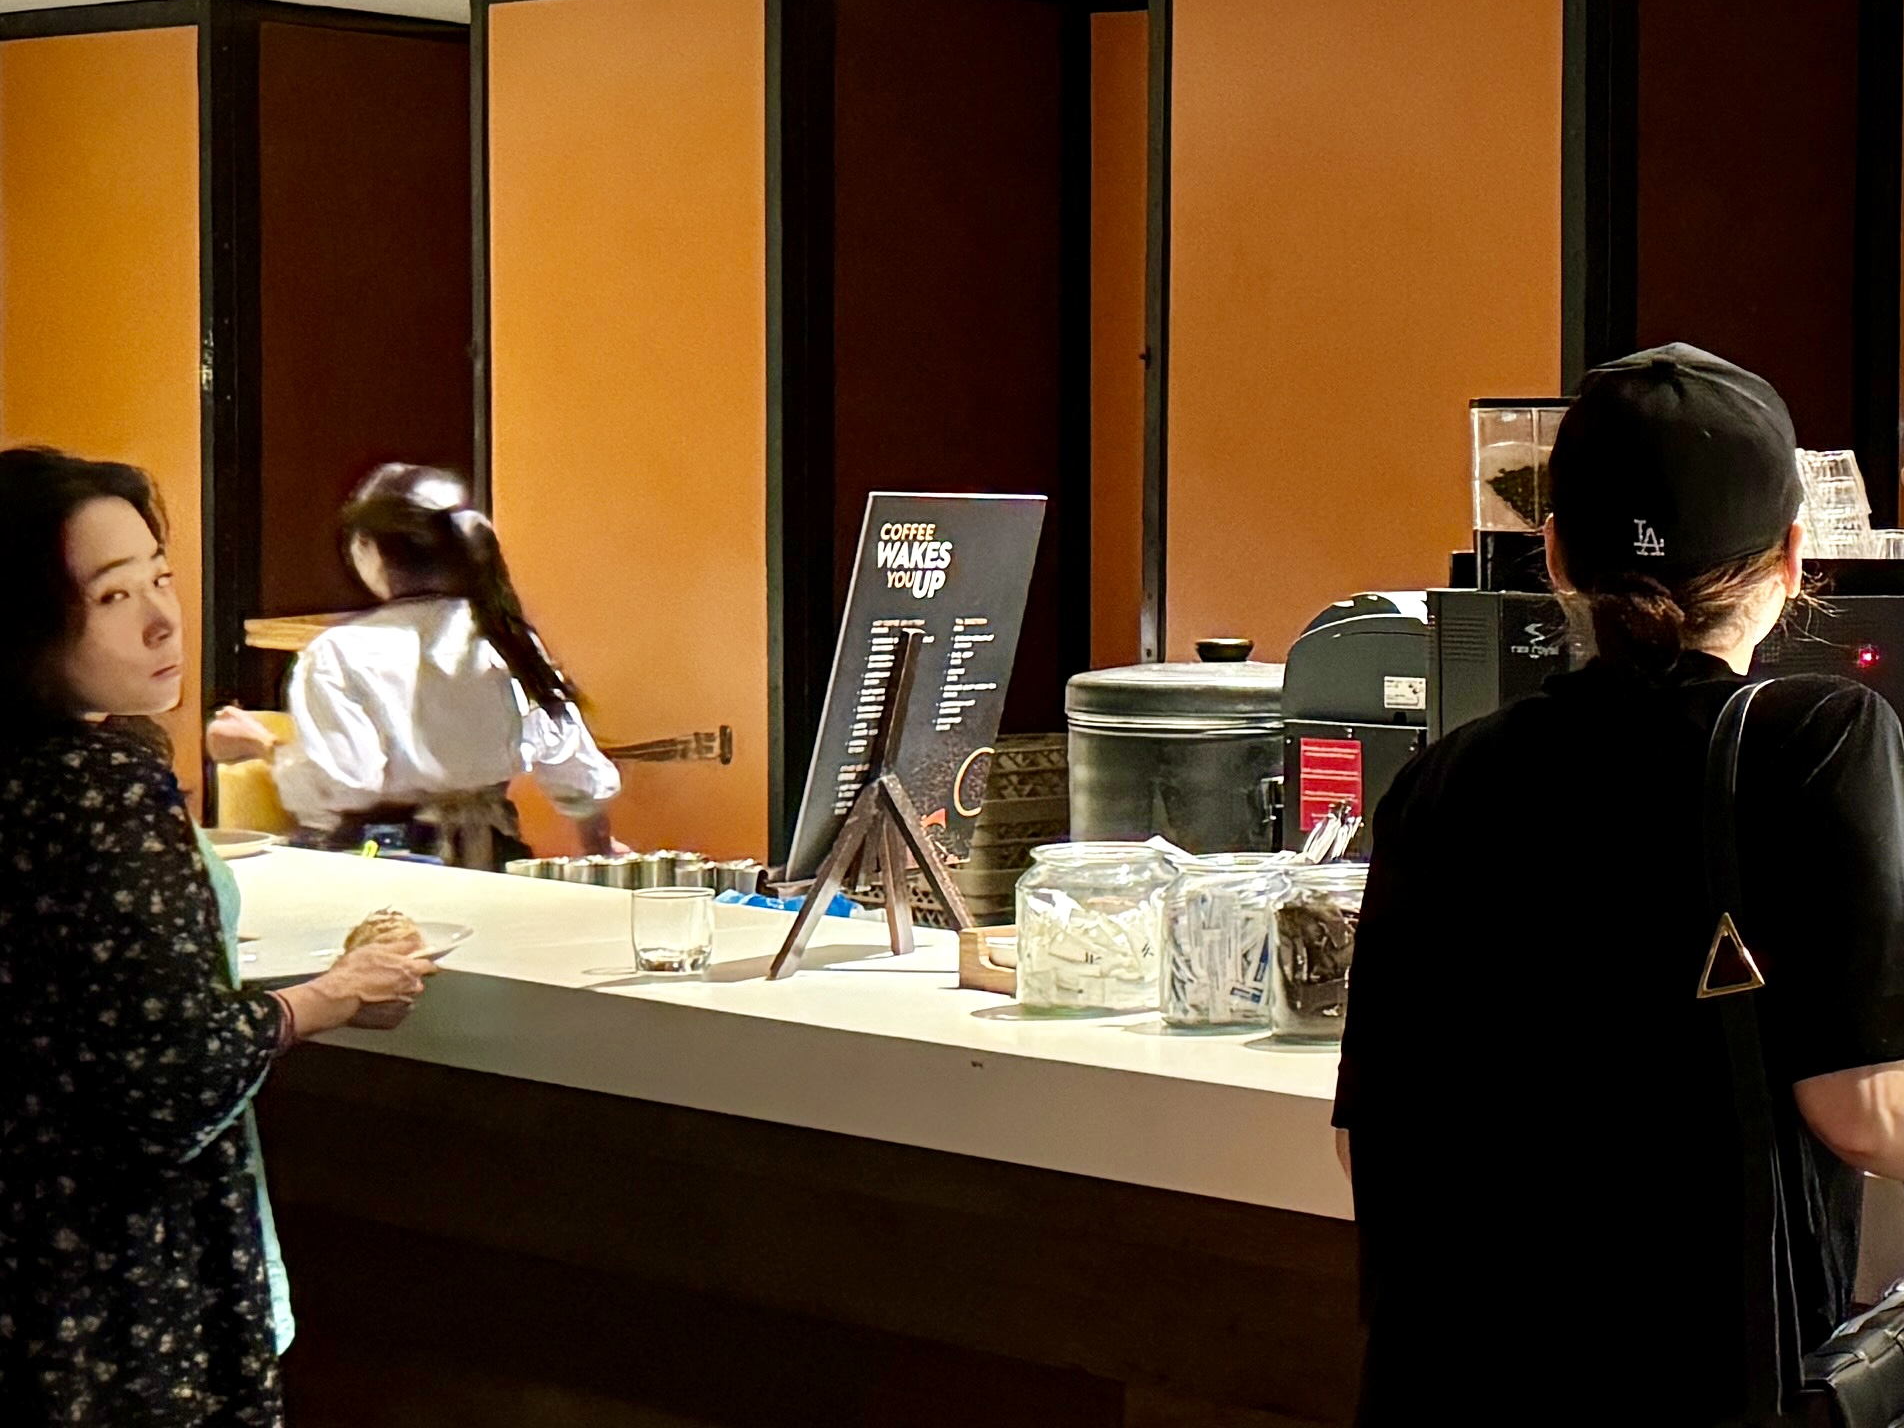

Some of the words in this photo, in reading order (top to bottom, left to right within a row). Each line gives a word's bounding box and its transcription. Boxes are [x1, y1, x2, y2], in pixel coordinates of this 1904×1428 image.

[879, 522, 937, 542] COFFEE
[1633, 518, 1665, 556] LA
[876, 540, 954, 569] WAKES
[886, 570, 915, 589] YOU
[911, 569, 947, 599] UP
